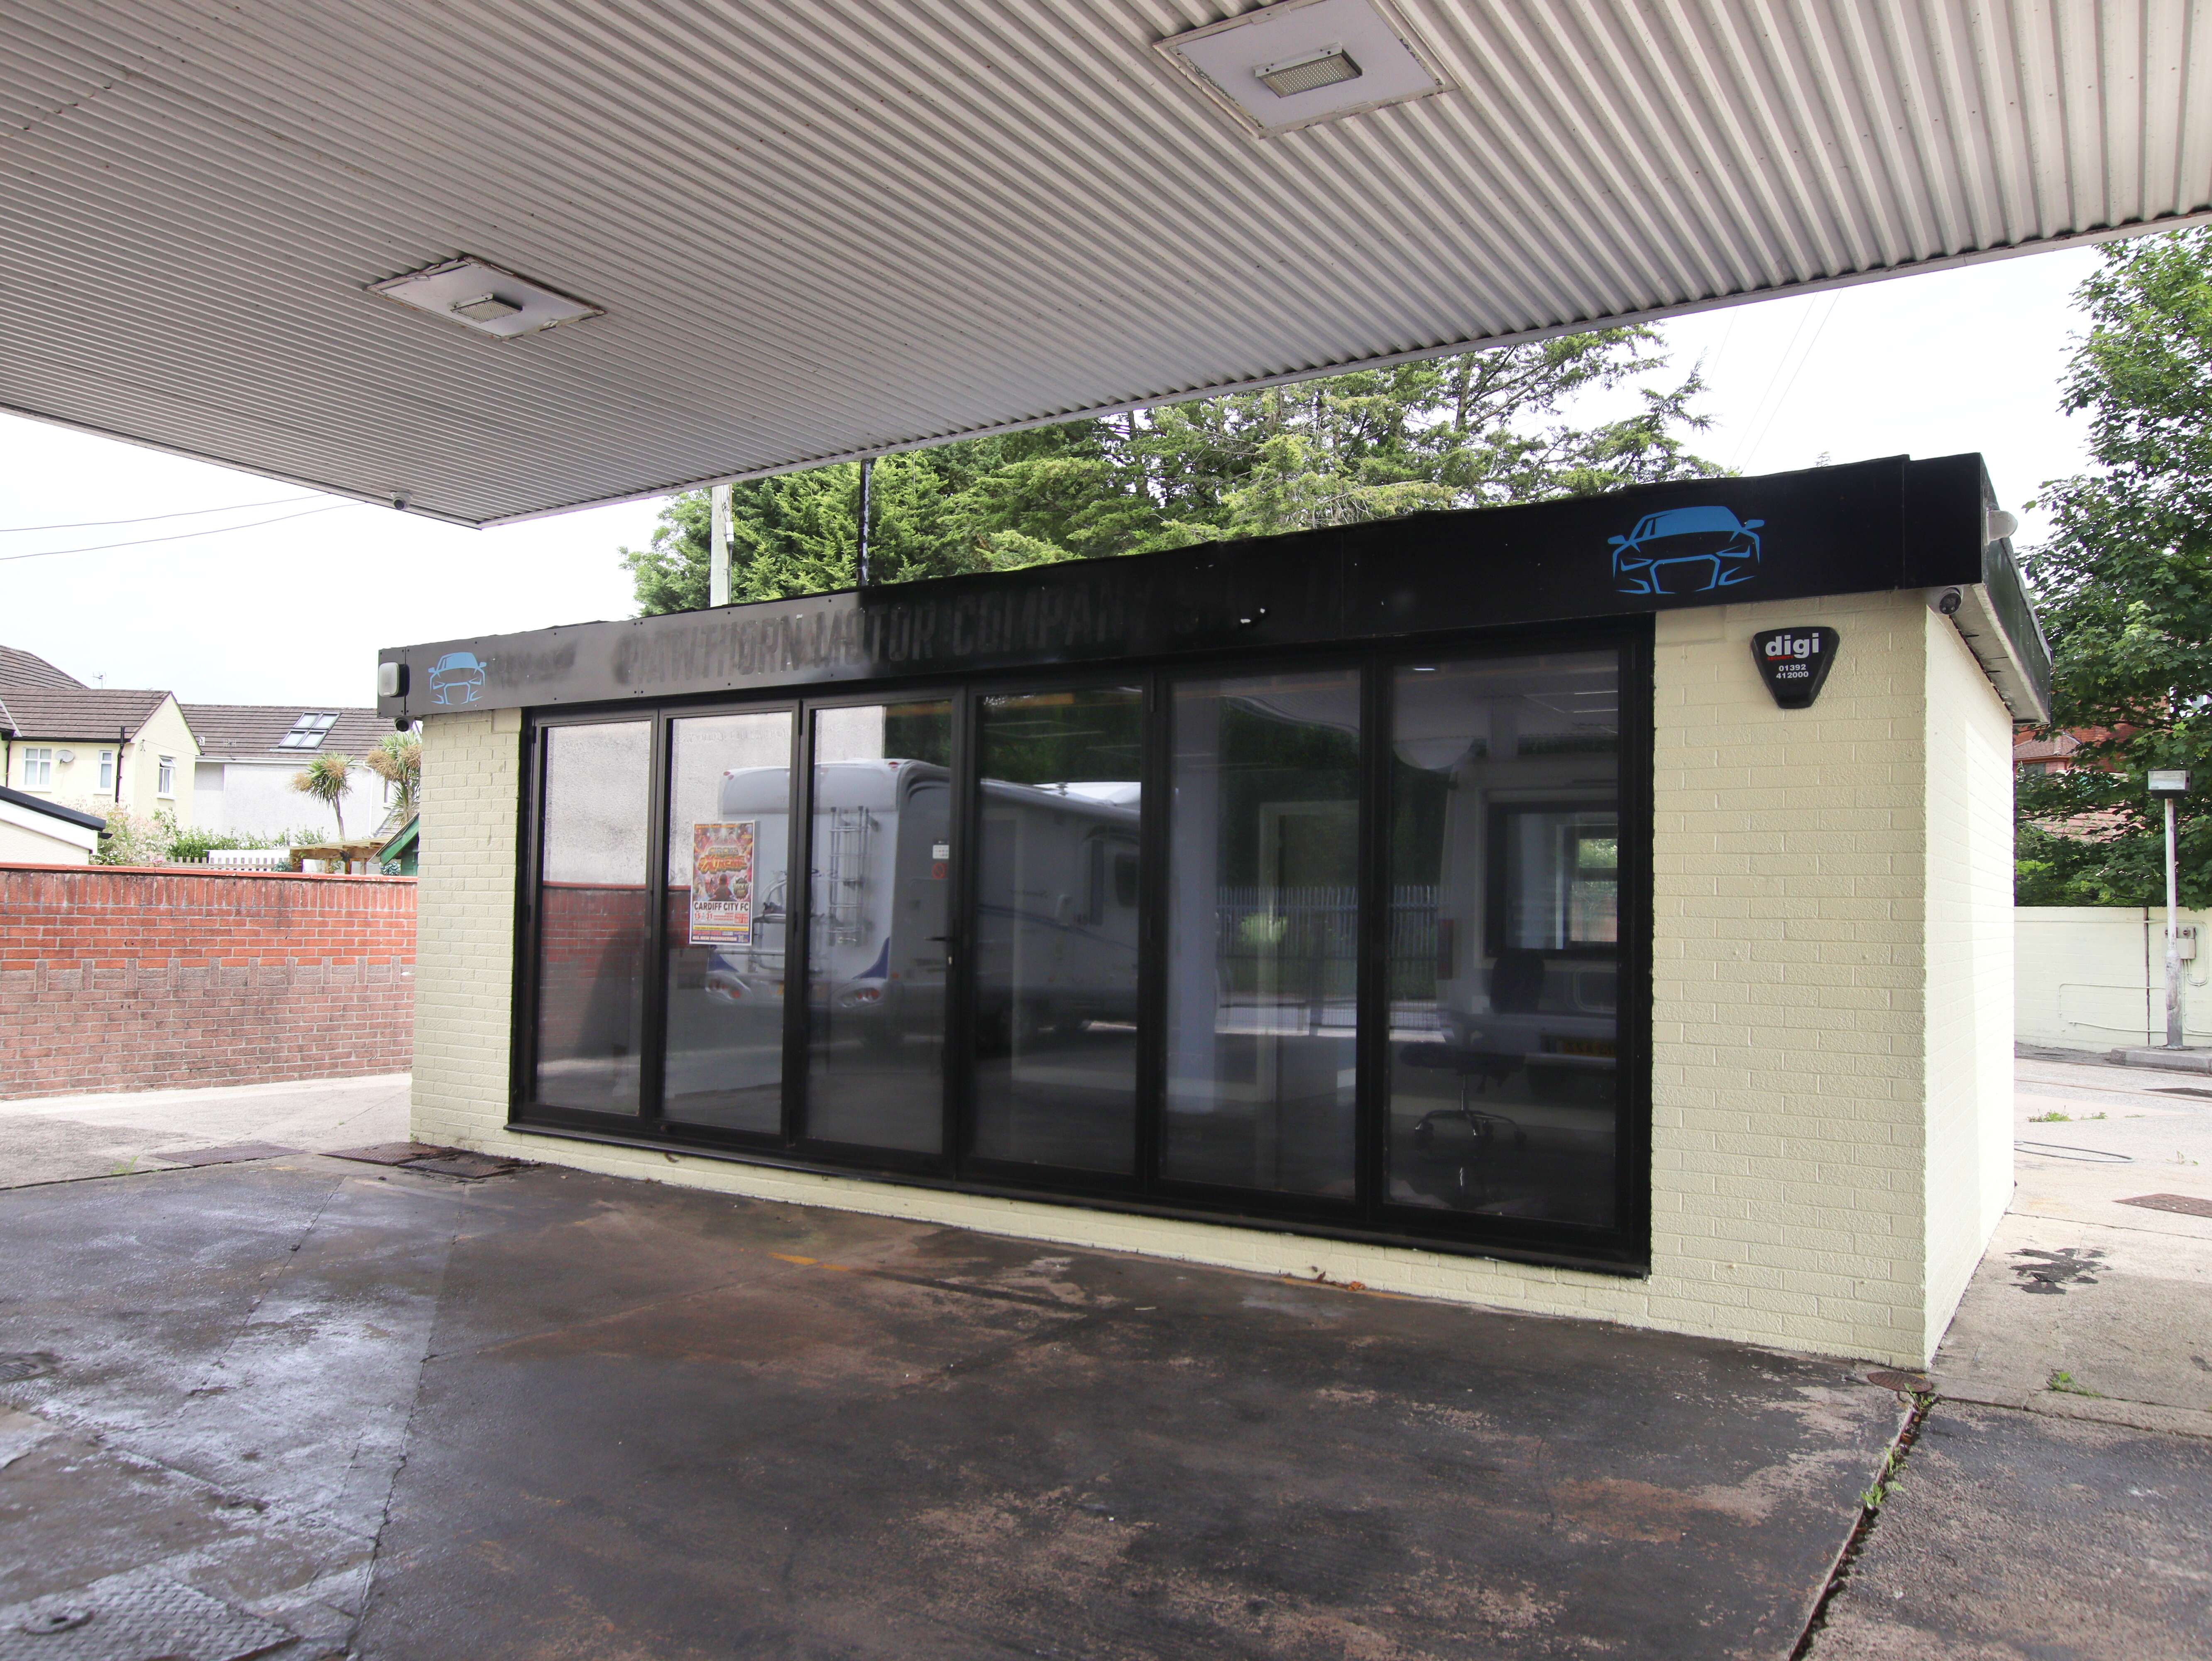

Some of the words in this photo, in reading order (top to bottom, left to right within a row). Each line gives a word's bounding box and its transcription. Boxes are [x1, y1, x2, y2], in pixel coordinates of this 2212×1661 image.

[1765, 633, 1819, 659] digi
[694, 902, 722, 911] CARDIFF
[724, 902, 739, 911] CITY
